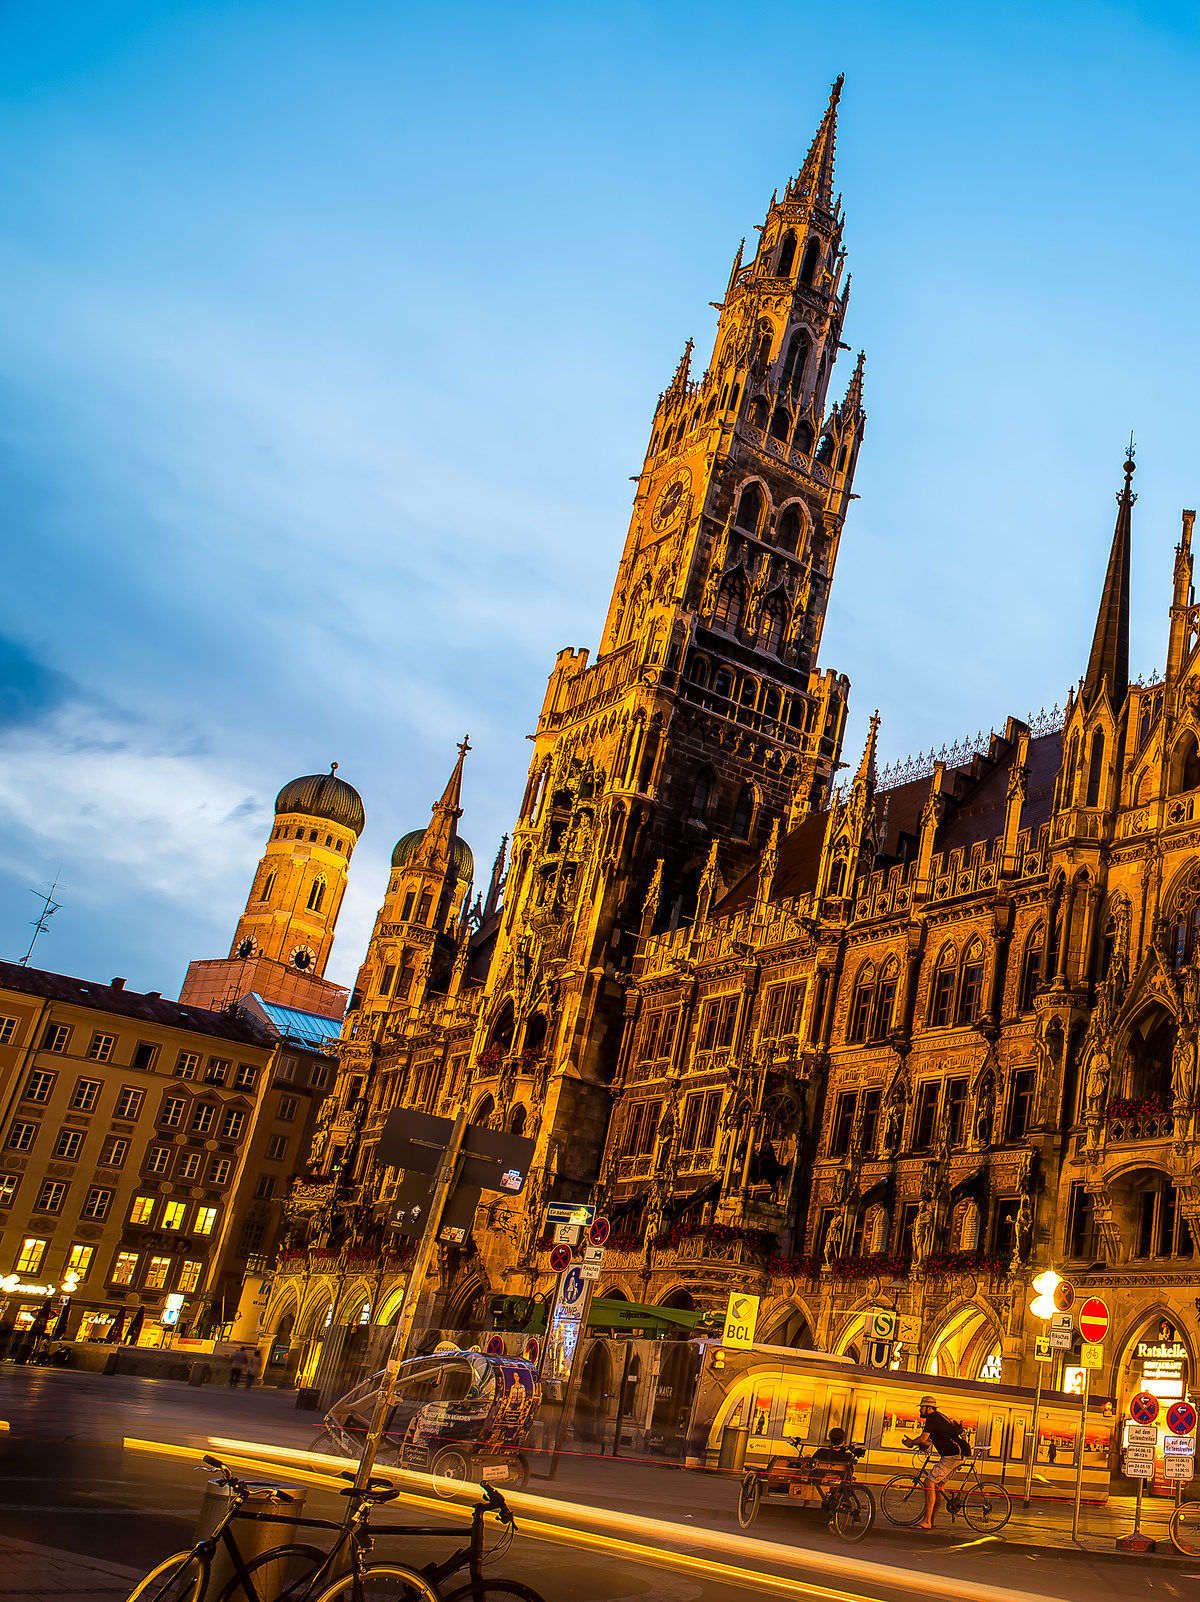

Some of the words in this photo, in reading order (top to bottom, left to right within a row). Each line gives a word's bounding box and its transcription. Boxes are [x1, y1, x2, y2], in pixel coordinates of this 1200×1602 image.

[726, 1324, 751, 1342] BCL
[876, 1313, 892, 1335] S
[870, 1343, 888, 1368] U
[988, 1354, 1003, 1367] RA
